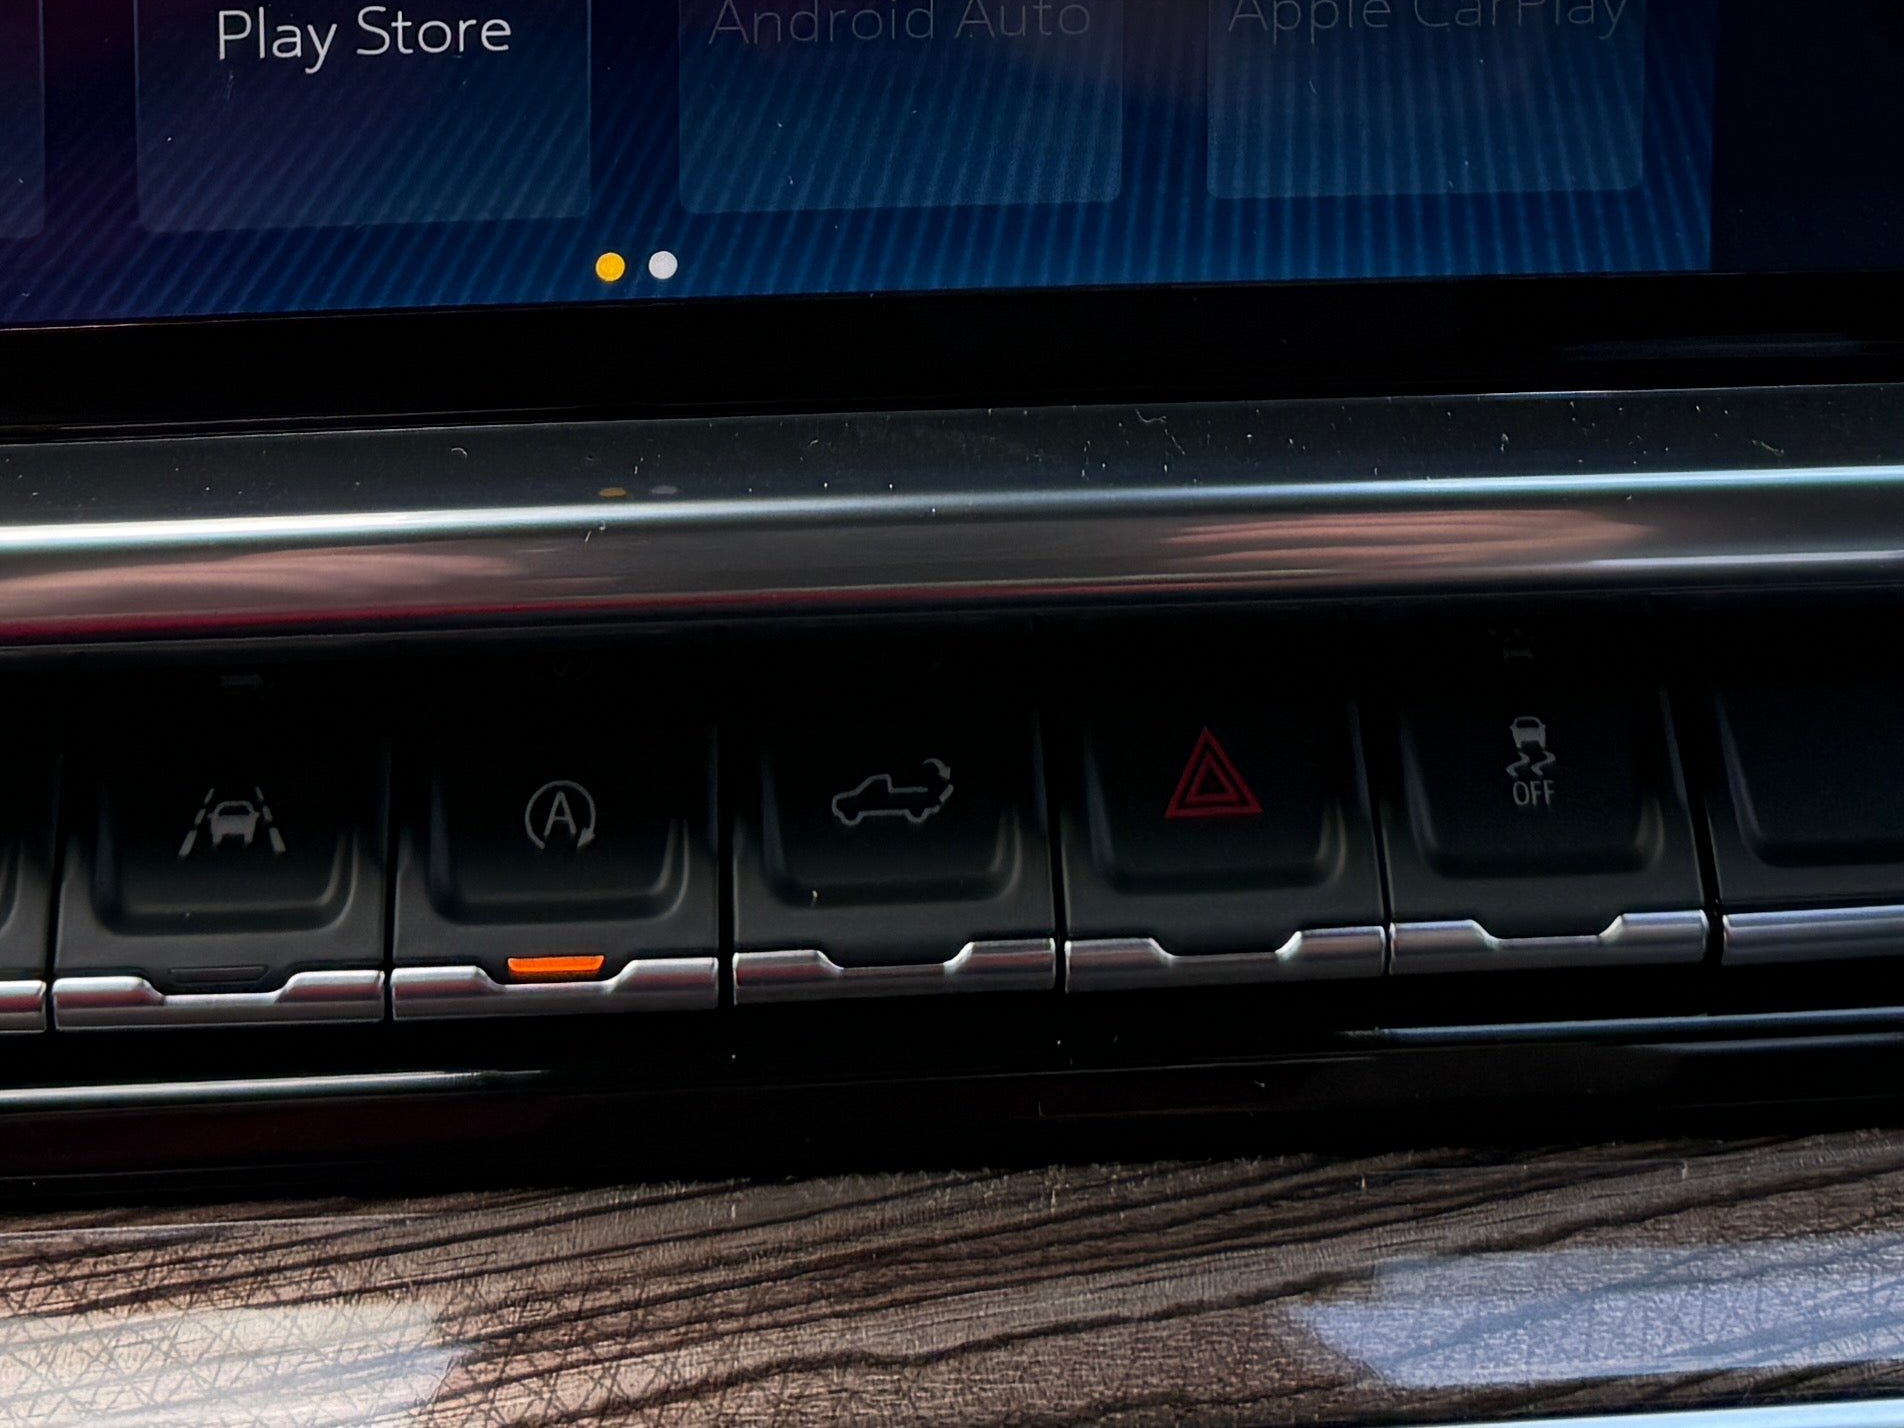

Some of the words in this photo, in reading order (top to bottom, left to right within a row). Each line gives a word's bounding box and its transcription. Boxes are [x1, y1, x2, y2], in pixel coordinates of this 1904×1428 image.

[217, 5, 338, 75] Play
[356, 4, 513, 57] Store
[543, 790, 577, 837] A
[1512, 779, 1555, 807] OFF
